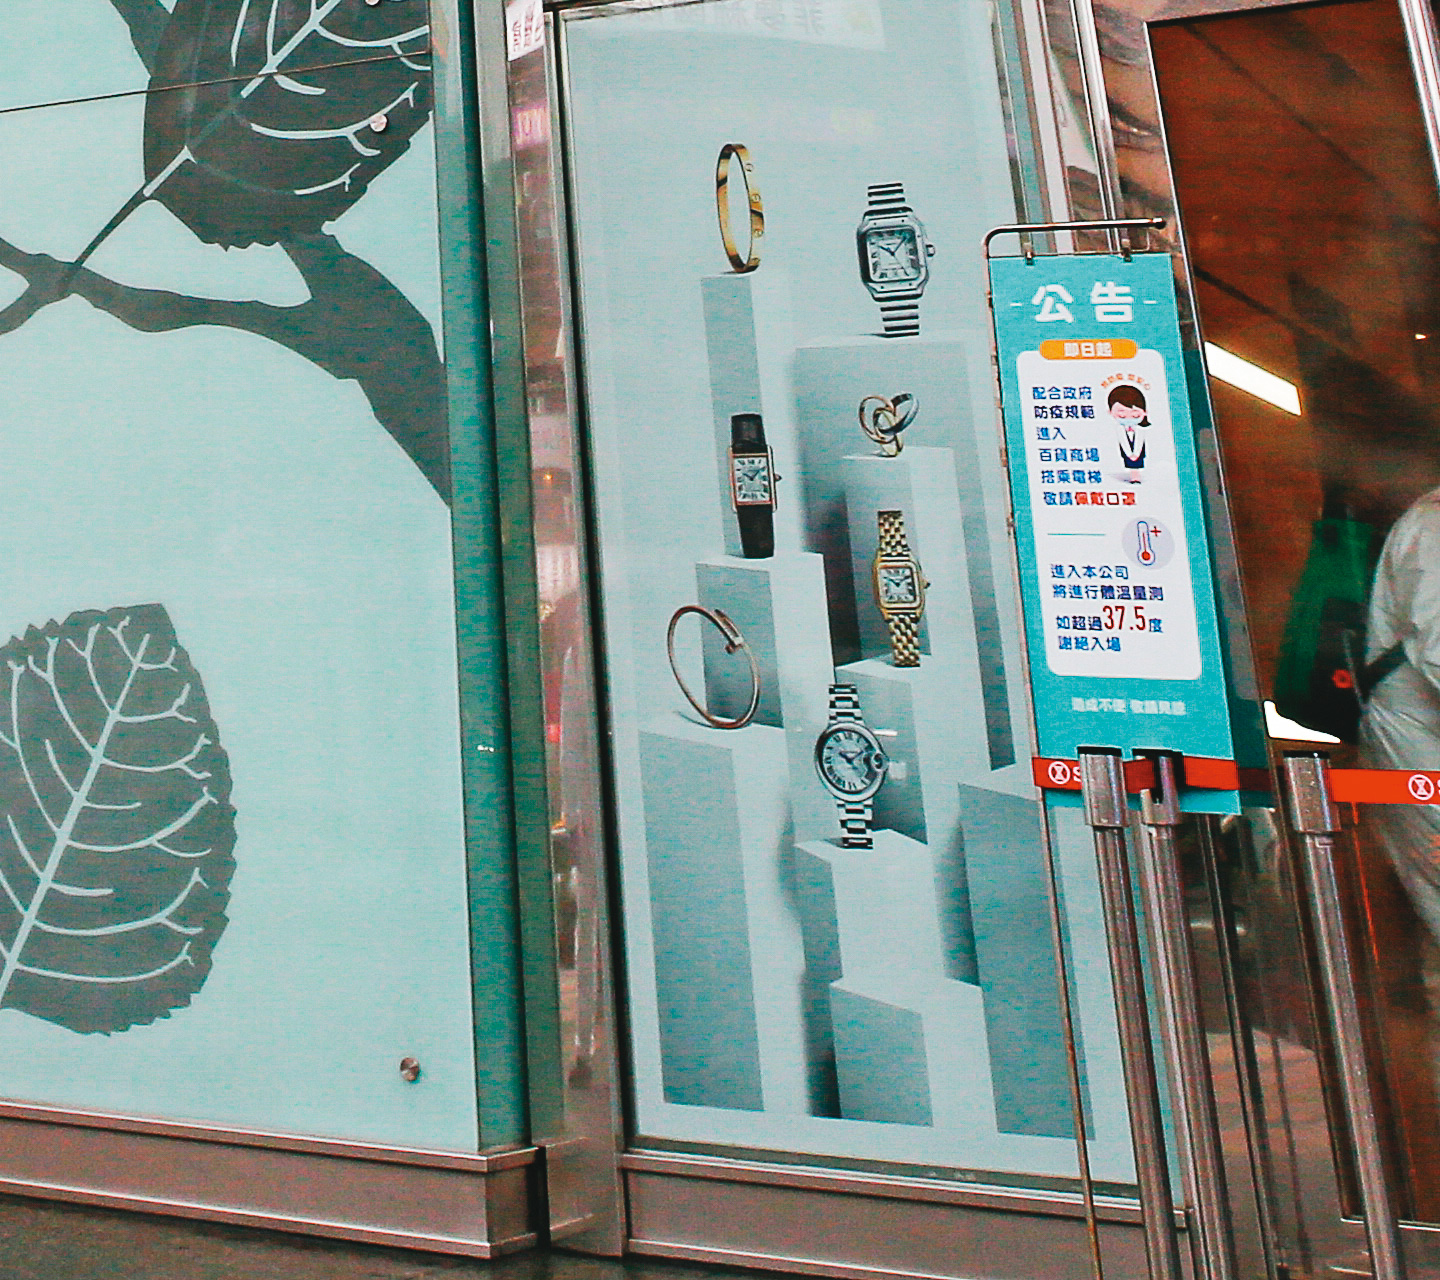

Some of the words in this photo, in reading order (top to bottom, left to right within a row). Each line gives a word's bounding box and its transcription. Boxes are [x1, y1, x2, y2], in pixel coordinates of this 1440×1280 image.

[1032, 280, 1135, 323] 公告
[1032, 386, 1093, 400] 配合政府
[1034, 405, 1095, 419] 防疫規範
[1036, 426, 1066, 441] 進入
[1039, 447, 1100, 463] 百貨商場
[1041, 469, 1102, 484] 搭乘電梯
[1051, 563, 1129, 580] 進入本公司
[1052, 584, 1164, 601] 將進行體溫量測
[1056, 605, 1164, 634] 如超過37.5度
[1058, 636, 1122, 652] 謝絕入場
